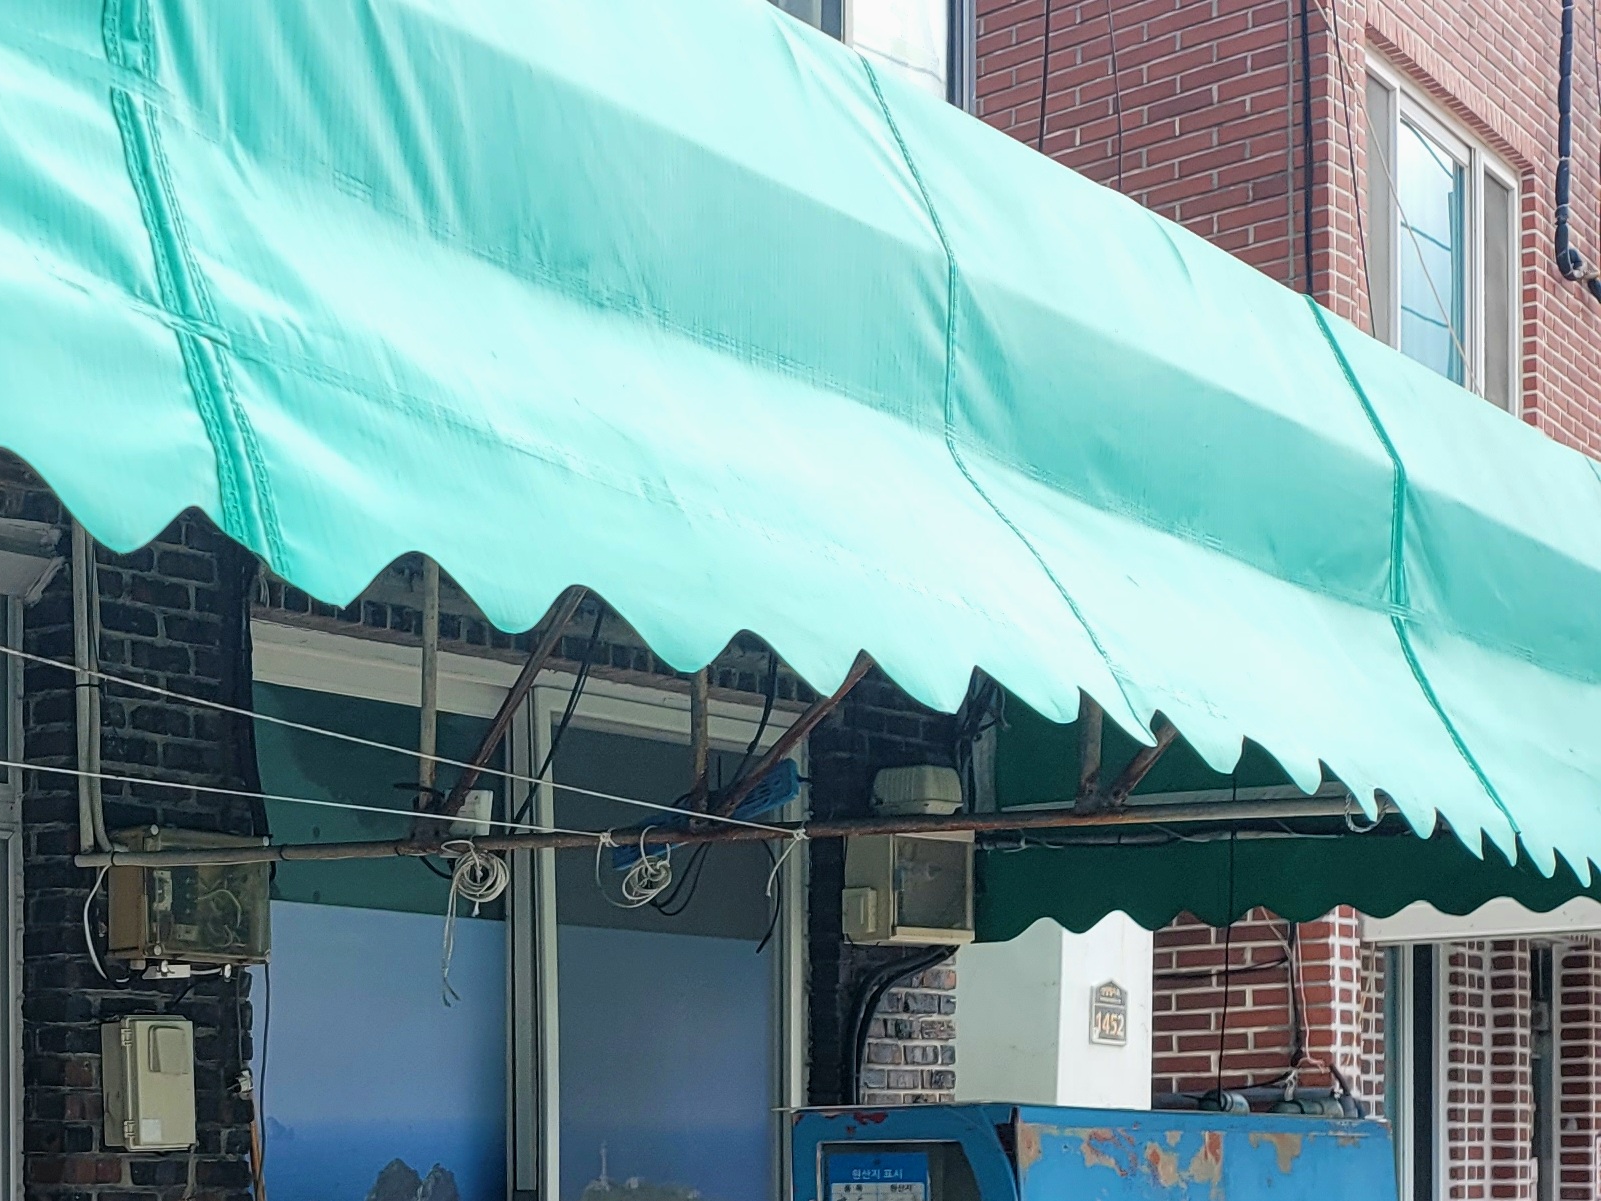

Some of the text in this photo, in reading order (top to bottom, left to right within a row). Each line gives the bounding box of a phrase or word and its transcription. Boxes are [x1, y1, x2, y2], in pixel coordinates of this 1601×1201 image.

[1095, 1011, 1125, 1036] 1452
[851, 1168, 903, 1180] 원산지 표시
